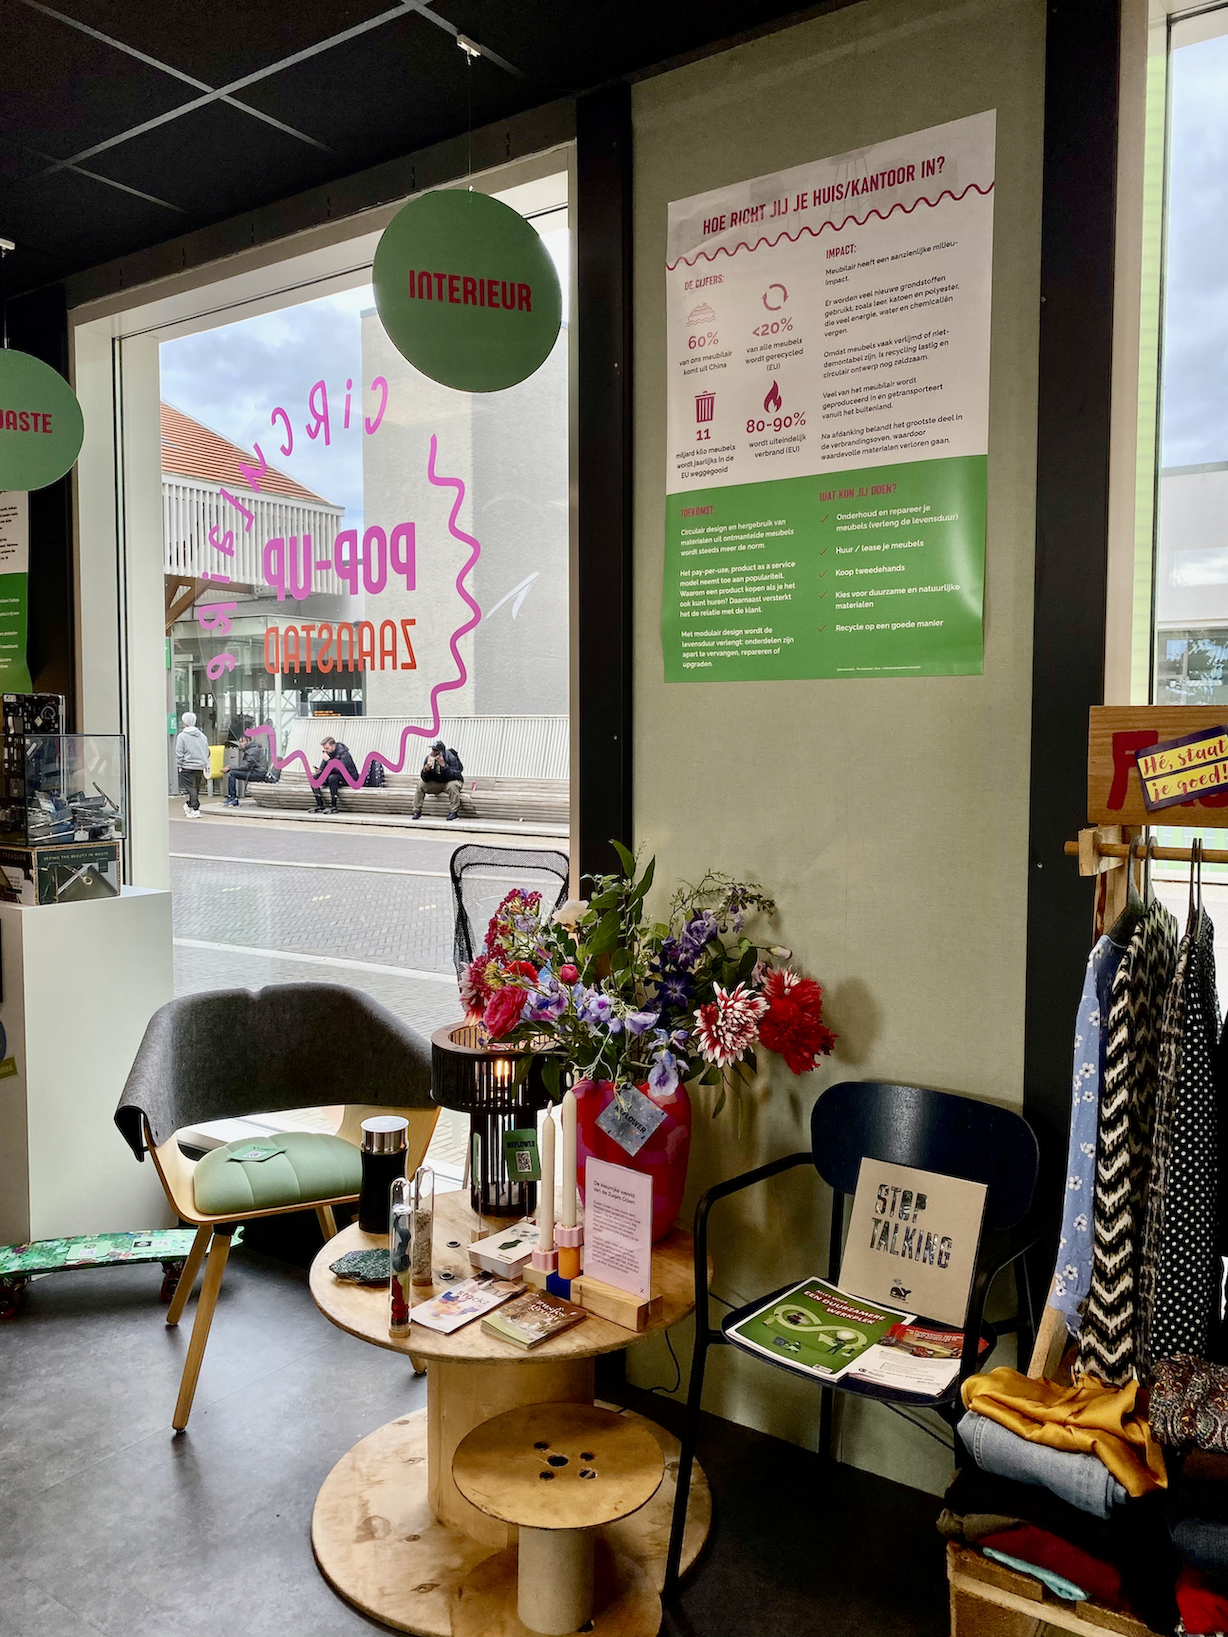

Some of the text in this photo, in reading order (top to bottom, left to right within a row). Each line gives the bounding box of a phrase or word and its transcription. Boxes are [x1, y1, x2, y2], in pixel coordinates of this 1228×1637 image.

[703, 156, 945, 234] HOE RICHT JIJ JE HUIS/KANTOOR IN?
[826, 244, 856, 259] IMPACT:
[826, 263, 856, 275] Meubilair
[857, 258, 875, 268] heeft
[891, 247, 931, 261] aanzienlijke
[933, 240, 958, 251] milieu-
[685, 274, 724, 291] DE CIJFERS:
[825, 275, 849, 286] impact.
[409, 269, 533, 312] INTERIEUR
[833, 295, 857, 304] worden
[859, 290, 873, 299] veel
[874, 286, 899, 296] nieuwe
[900, 276, 946, 292] grondstoffen
[824, 304, 853, 318] gebruikt,
[855, 301, 872, 310] zoals
[890, 294, 913, 303] katoen
[925, 284, 959, 297] polyester,
[824, 319, 834, 327] die
[836, 316, 850, 324] veel
[851, 311, 878, 321] energie,
[879, 307, 898, 316] water
[910, 296, 953, 310] chemicaliën
[752, 317, 793, 337] <20%
[824, 328, 848, 337] vergen.
[688, 331, 719, 349] 60%
[760, 343, 772, 351] alle
[774, 338, 802, 348] meubels
[824, 347, 846, 357] Omdat
[847, 343, 876, 353] meubels
[877, 339, 892, 348] vaak
[894, 334, 922, 345] verlijmd
[932, 329, 949, 338] niet-
[703, 350, 732, 361] meubilair
[745, 348, 803, 364] wordt gerecycled
[824, 355, 863, 368] demontabel
[864, 353, 877, 362] zijn,
[886, 345, 916, 357] recycling
[918, 341, 938, 351] lastig
[683, 367, 698, 375] komt
[709, 363, 727, 371] China
[767, 363, 780, 371] (EU)
[823, 355, 929, 378] circulair ontwerp nog zeldzaam.
[0, 412, 53, 434] ASTE
[746, 411, 806, 433] 80-90%
[696, 428, 711, 441] 11
[748, 434, 806, 447] wordt uiteindelijk
[676, 444, 736, 459] miljard kilo meubels
[755, 446, 800, 457] verbrand (EU)
[677, 460, 693, 469] wordt
[693, 458, 717, 468] jaarlijks
[690, 466, 728, 478] weggegooid
[820, 483, 897, 502] WAT KUN JIJ DOEN?
[680, 505, 715, 517] TOEKOMST:
[836, 510, 877, 521] Onderhoud
[889, 507, 922, 516] repareer
[922, 505, 930, 514] je
[681, 527, 705, 536] Circulair
[706, 525, 727, 533] design
[738, 520, 773, 530] hergebruik
[836, 523, 867, 532] meubels
[869, 519, 899, 530] (verleng
[912, 513, 958, 524] levensduur)
[680, 537, 712, 546] materialen
[723, 532, 764, 542] ontmantelde
[765, 529, 794, 538] meubels
[855, 545, 860, 553] /
[882, 543, 889, 552] je
[891, 540, 924, 549] meubels
[836, 565, 905, 577] Koop tweedehands
[919, 584, 960, 593] natuurlijke
[836, 601, 874, 609] materialen
[836, 624, 864, 633] Recycle
[865, 623, 874, 632] op
[891, 621, 915, 631] goede
[1144, 740, 1228, 775] Hé, staat
[1152, 764, 1227, 804] je goed!
[875, 1184, 928, 1224] STOP
[870, 1217, 953, 1269] TALKING
[803, 1290, 822, 1302] EEN
[822, 1298, 886, 1321] DUURZAMERE
[826, 1307, 876, 1325] WERKPLEK
